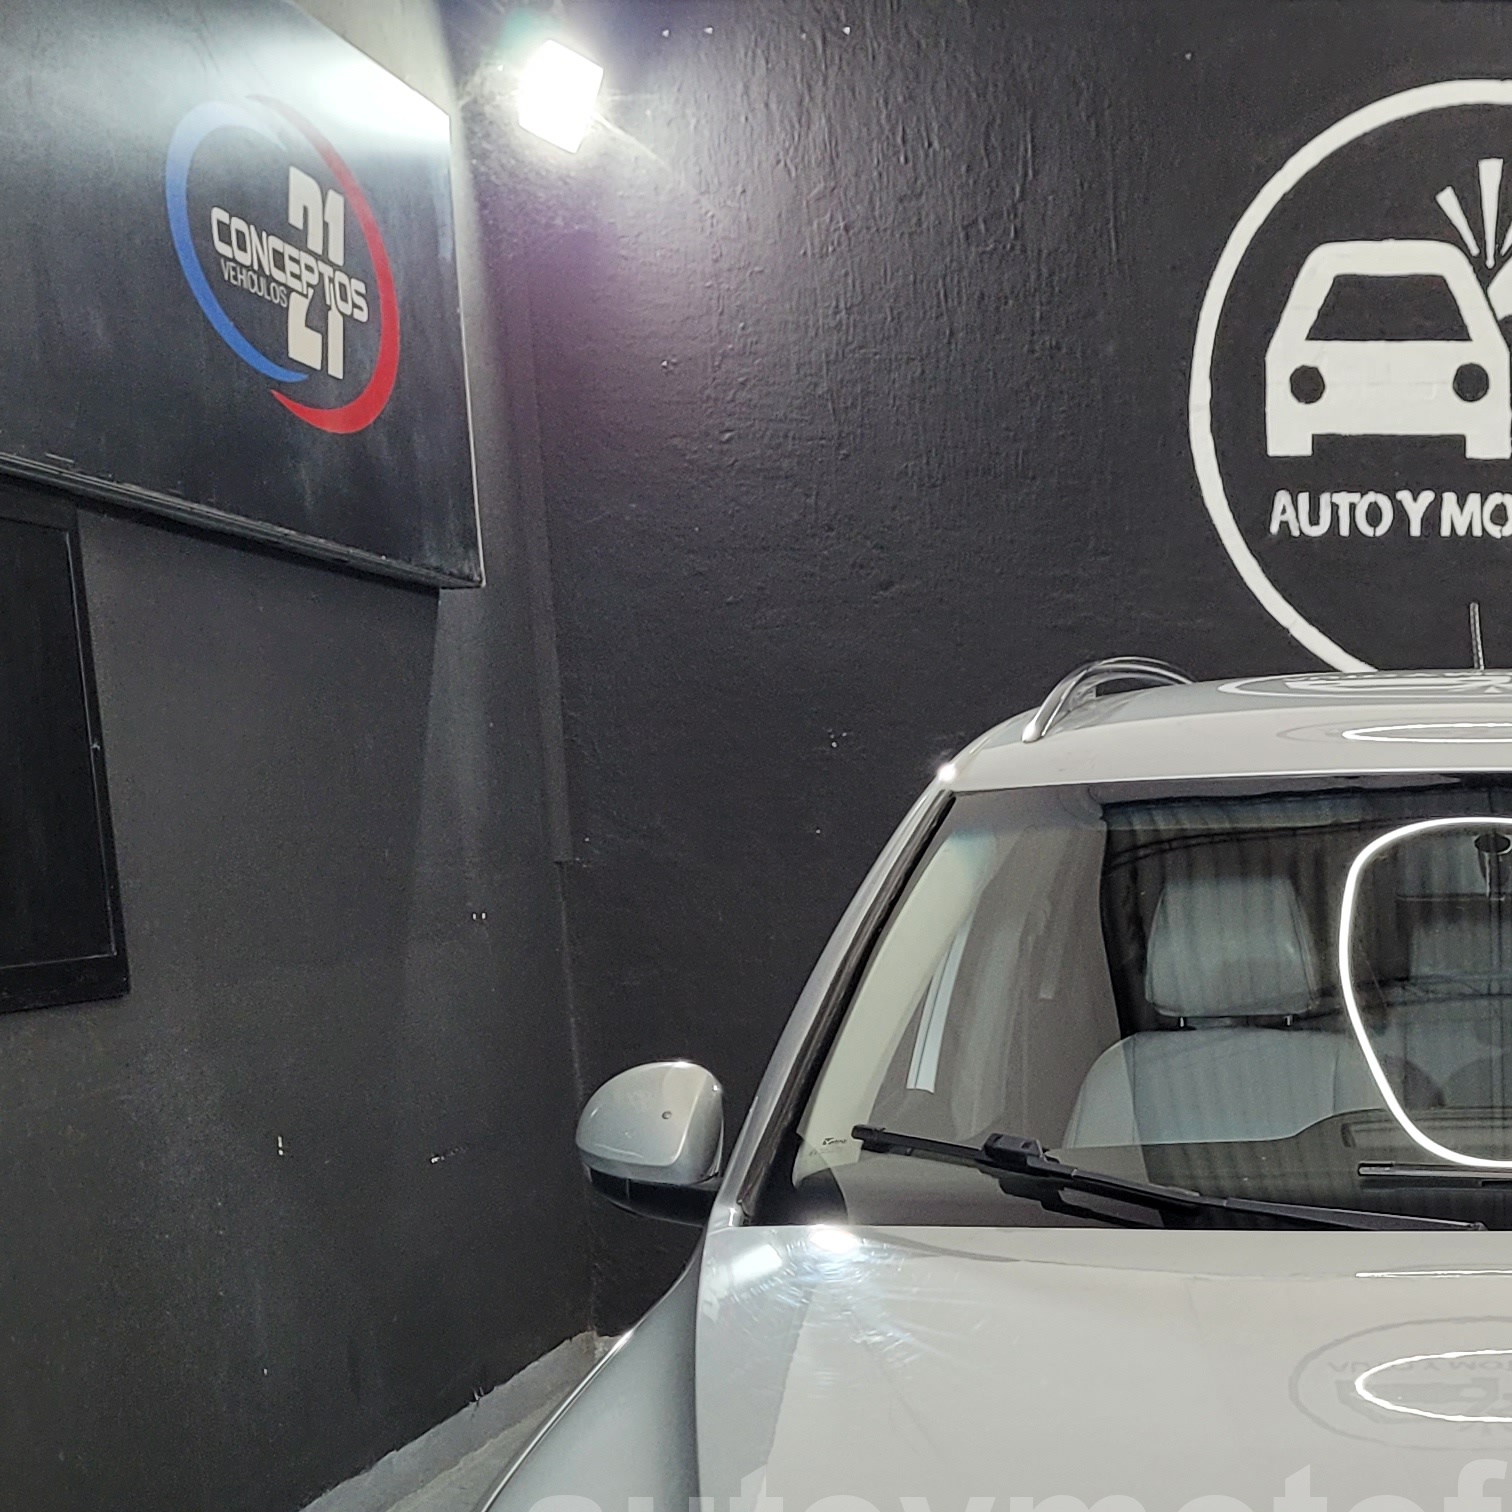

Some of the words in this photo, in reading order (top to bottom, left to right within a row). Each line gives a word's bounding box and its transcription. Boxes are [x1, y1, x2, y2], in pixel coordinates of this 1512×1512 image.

[211, 206, 369, 323] CONCEPTOS
[1269, 489, 1394, 538] AUTO
[1395, 489, 1436, 538] Y
